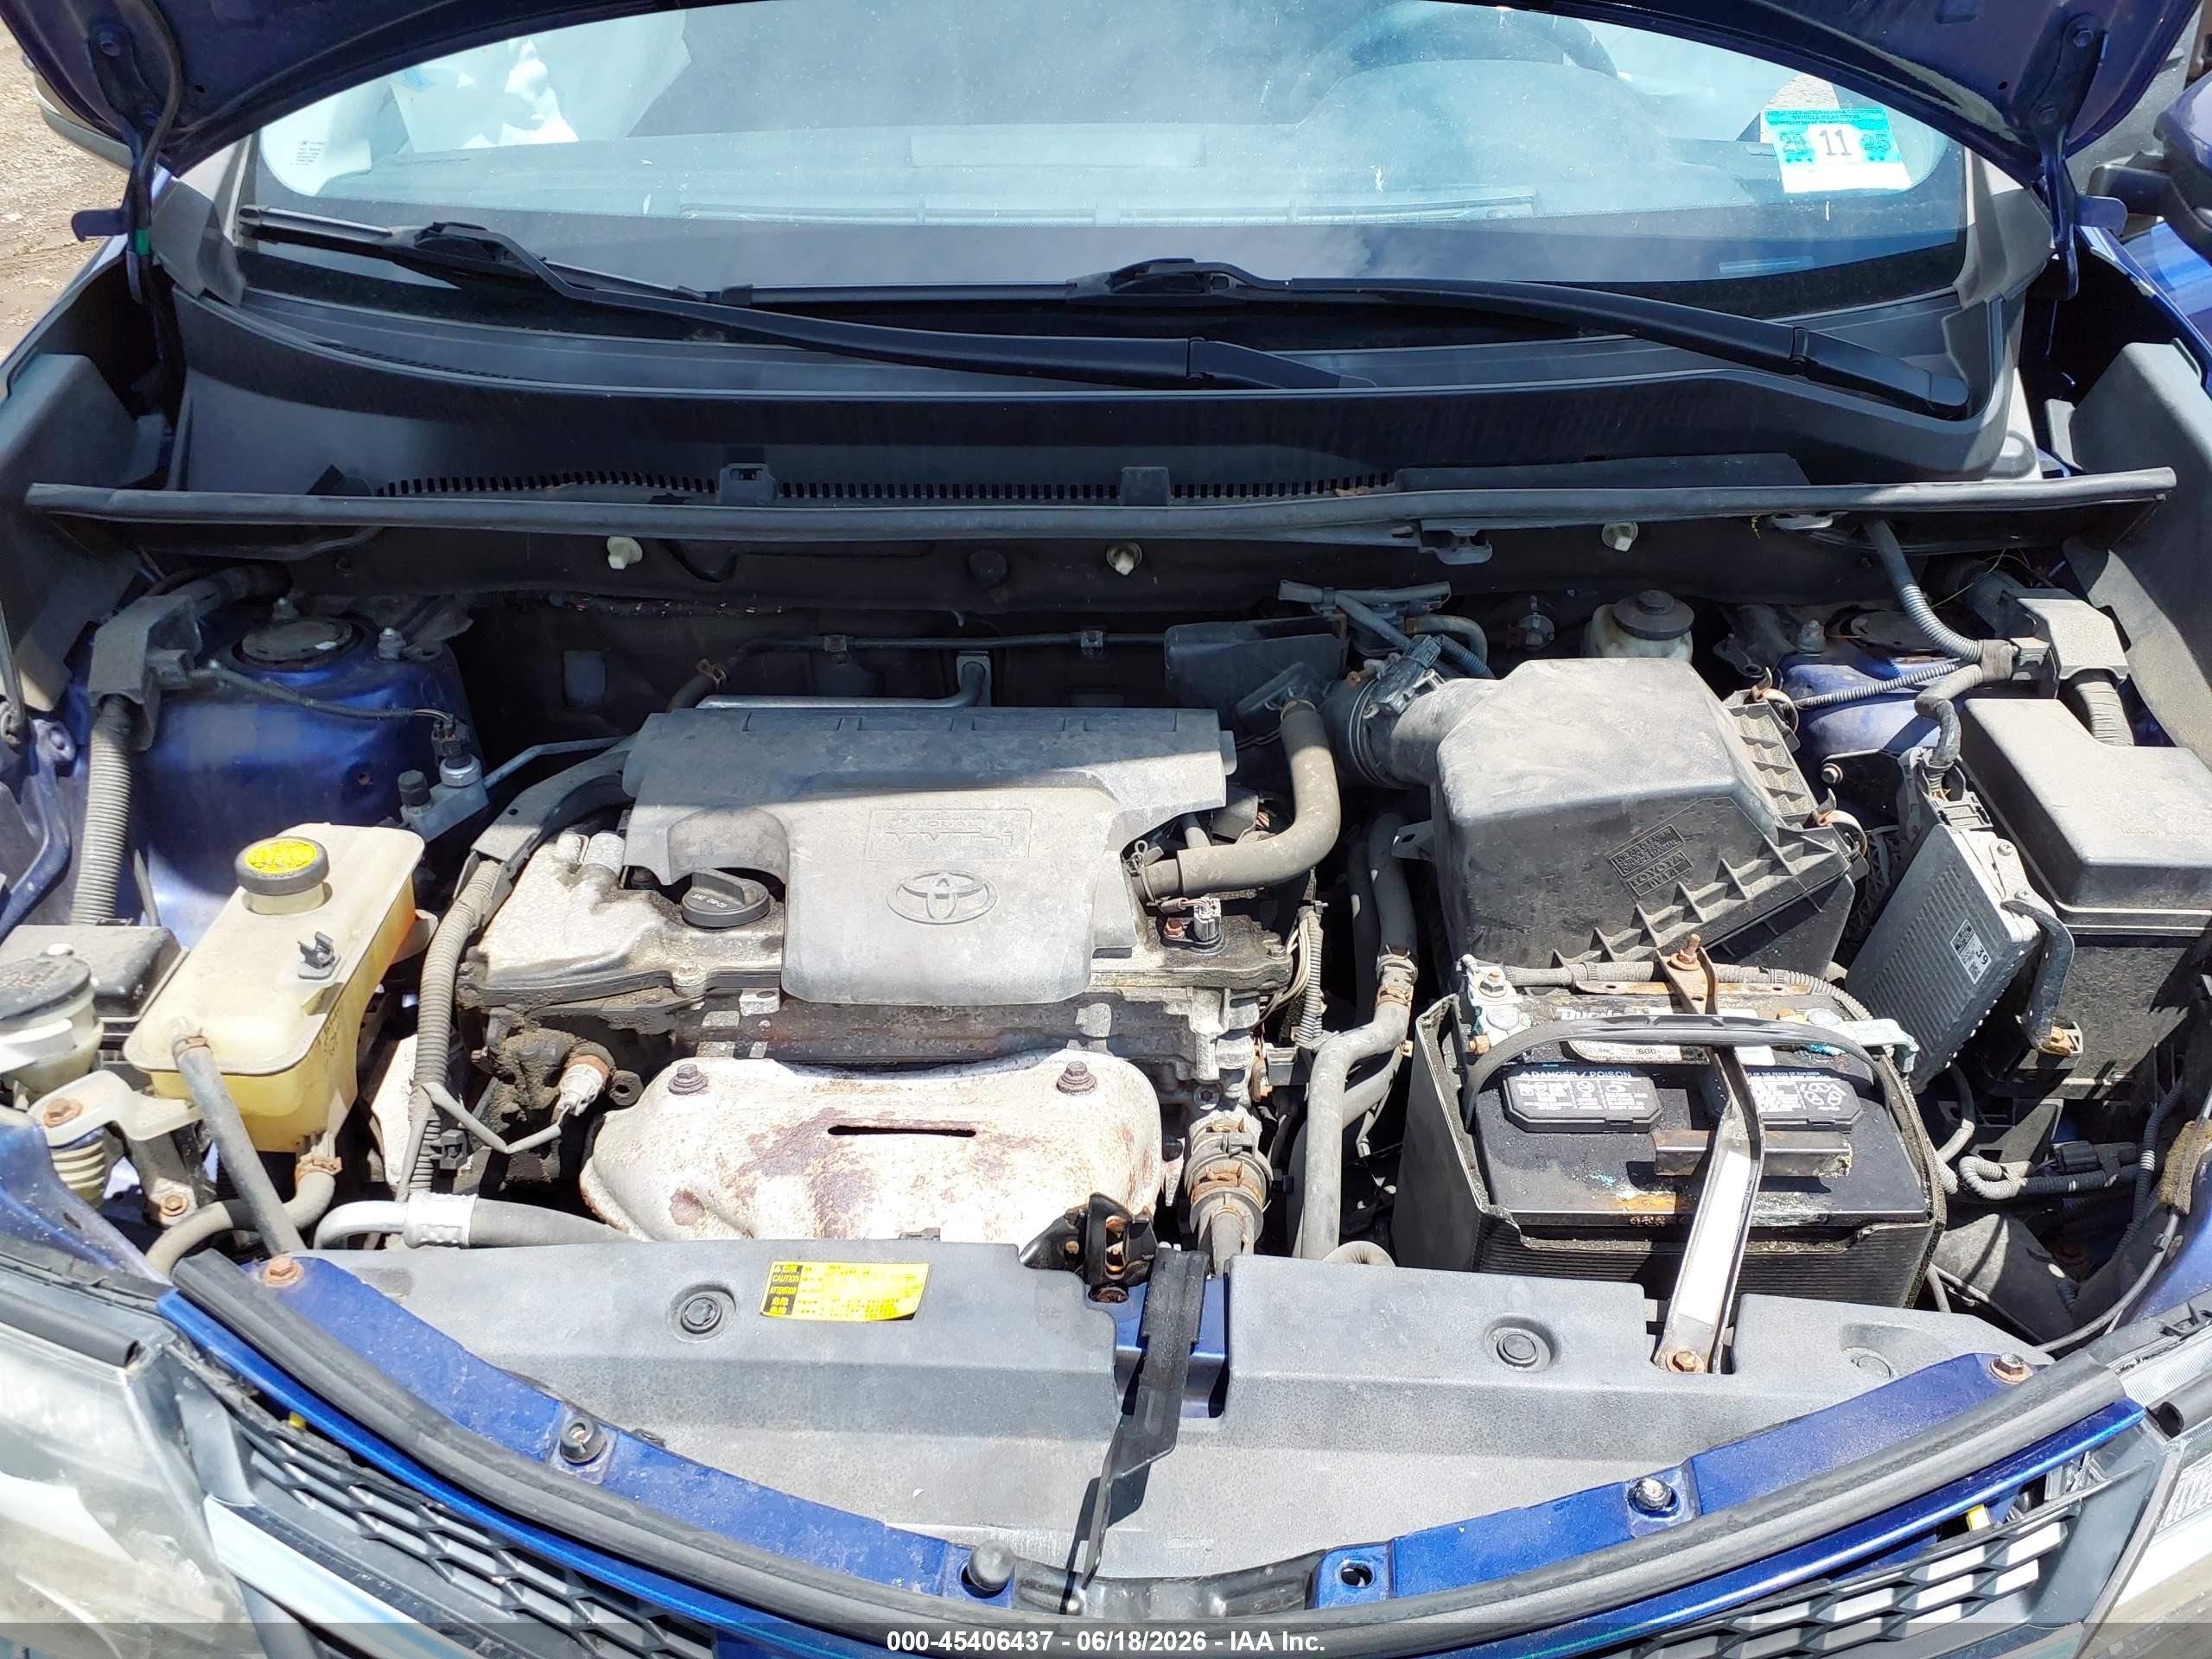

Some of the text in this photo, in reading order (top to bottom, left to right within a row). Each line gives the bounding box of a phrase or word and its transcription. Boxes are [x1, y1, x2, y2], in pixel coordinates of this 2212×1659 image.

[1819, 130, 1852, 156] 11
[1860, 133, 1891, 153] 25
[1631, 853, 1684, 887] TOYOTA
[1976, 946, 1989, 964] 39
[772, 1274, 800, 1283] CAUTION
